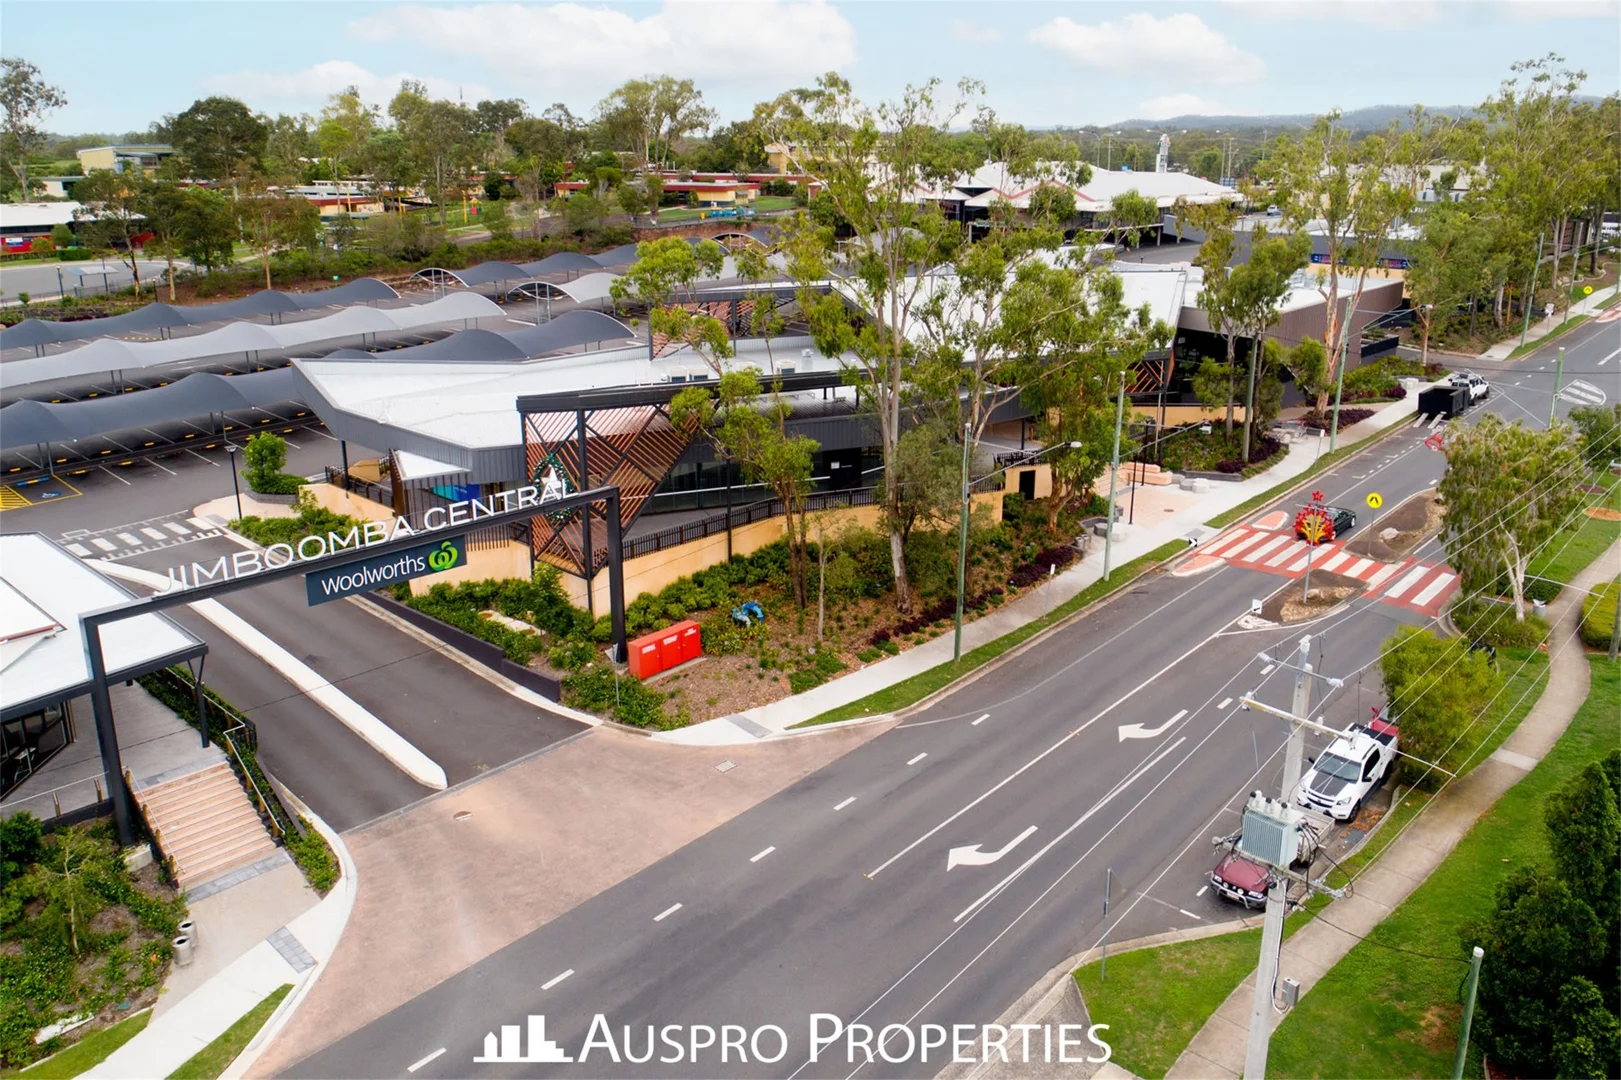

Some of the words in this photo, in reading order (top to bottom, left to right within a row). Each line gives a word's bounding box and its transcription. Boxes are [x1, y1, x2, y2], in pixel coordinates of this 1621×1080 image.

[153, 515, 416, 596] JIMBOOMBA
[424, 478, 579, 530] CENTRAL
[321, 554, 425, 596] Woolworths
